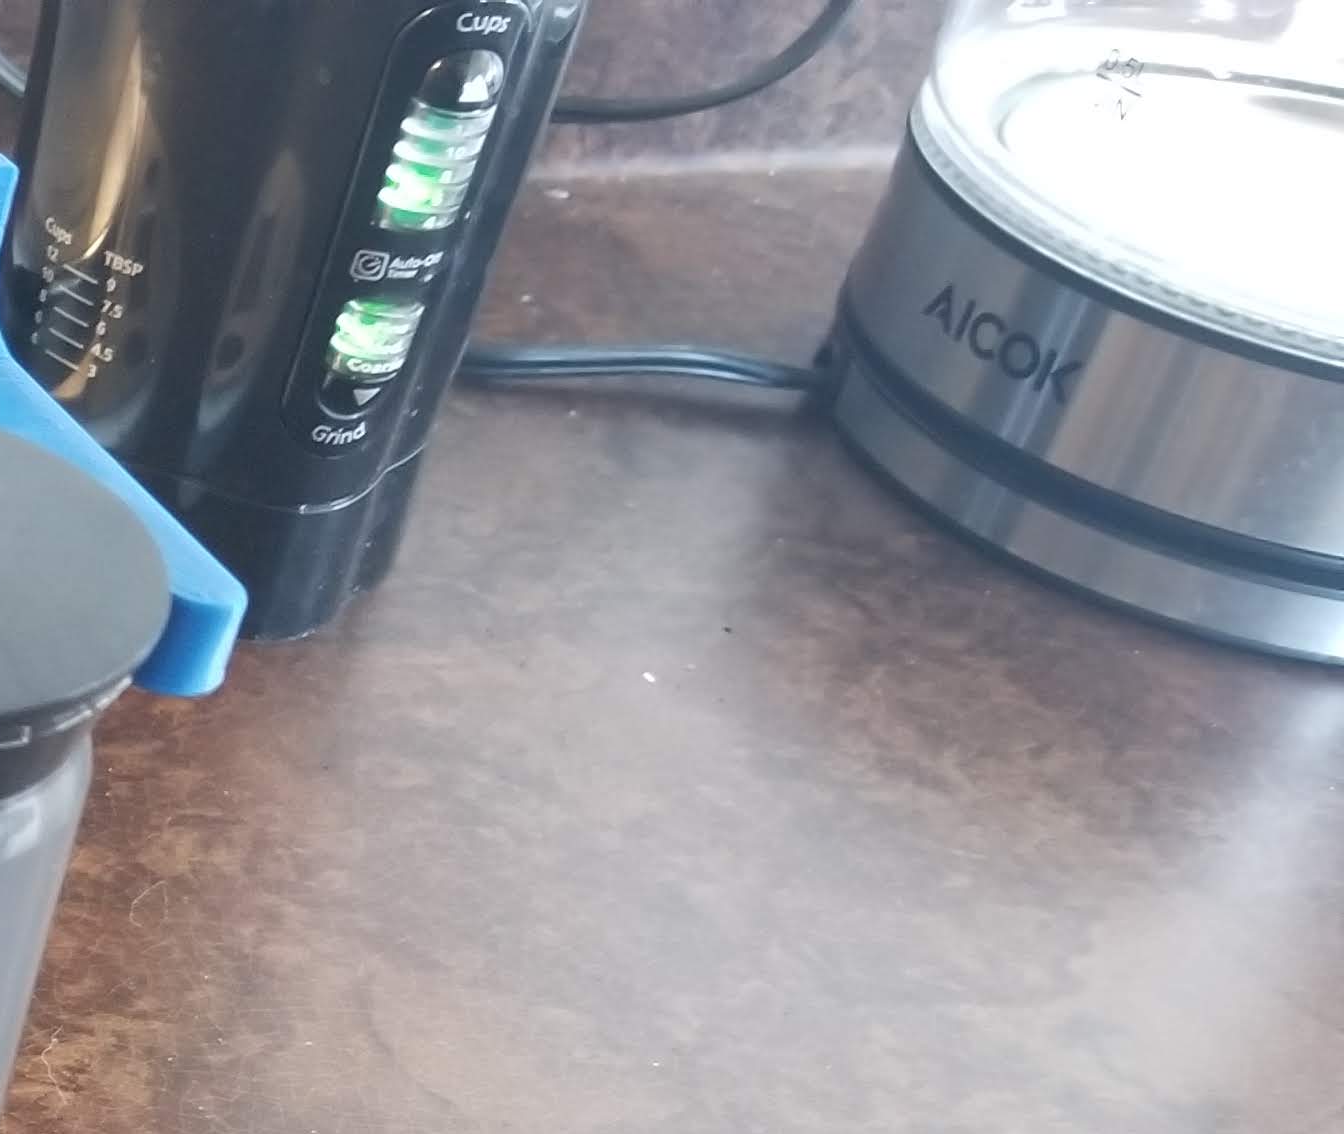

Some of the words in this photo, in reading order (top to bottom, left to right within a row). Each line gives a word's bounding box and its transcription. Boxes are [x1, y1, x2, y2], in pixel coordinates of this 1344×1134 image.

[456, 12, 512, 36] Cups
[45, 217, 73, 246] Cups
[104, 250, 144, 277] TBSP
[101, 299, 124, 320] 7.5
[921, 283, 1085, 405] AICOK
[311, 420, 368, 446] Grind
